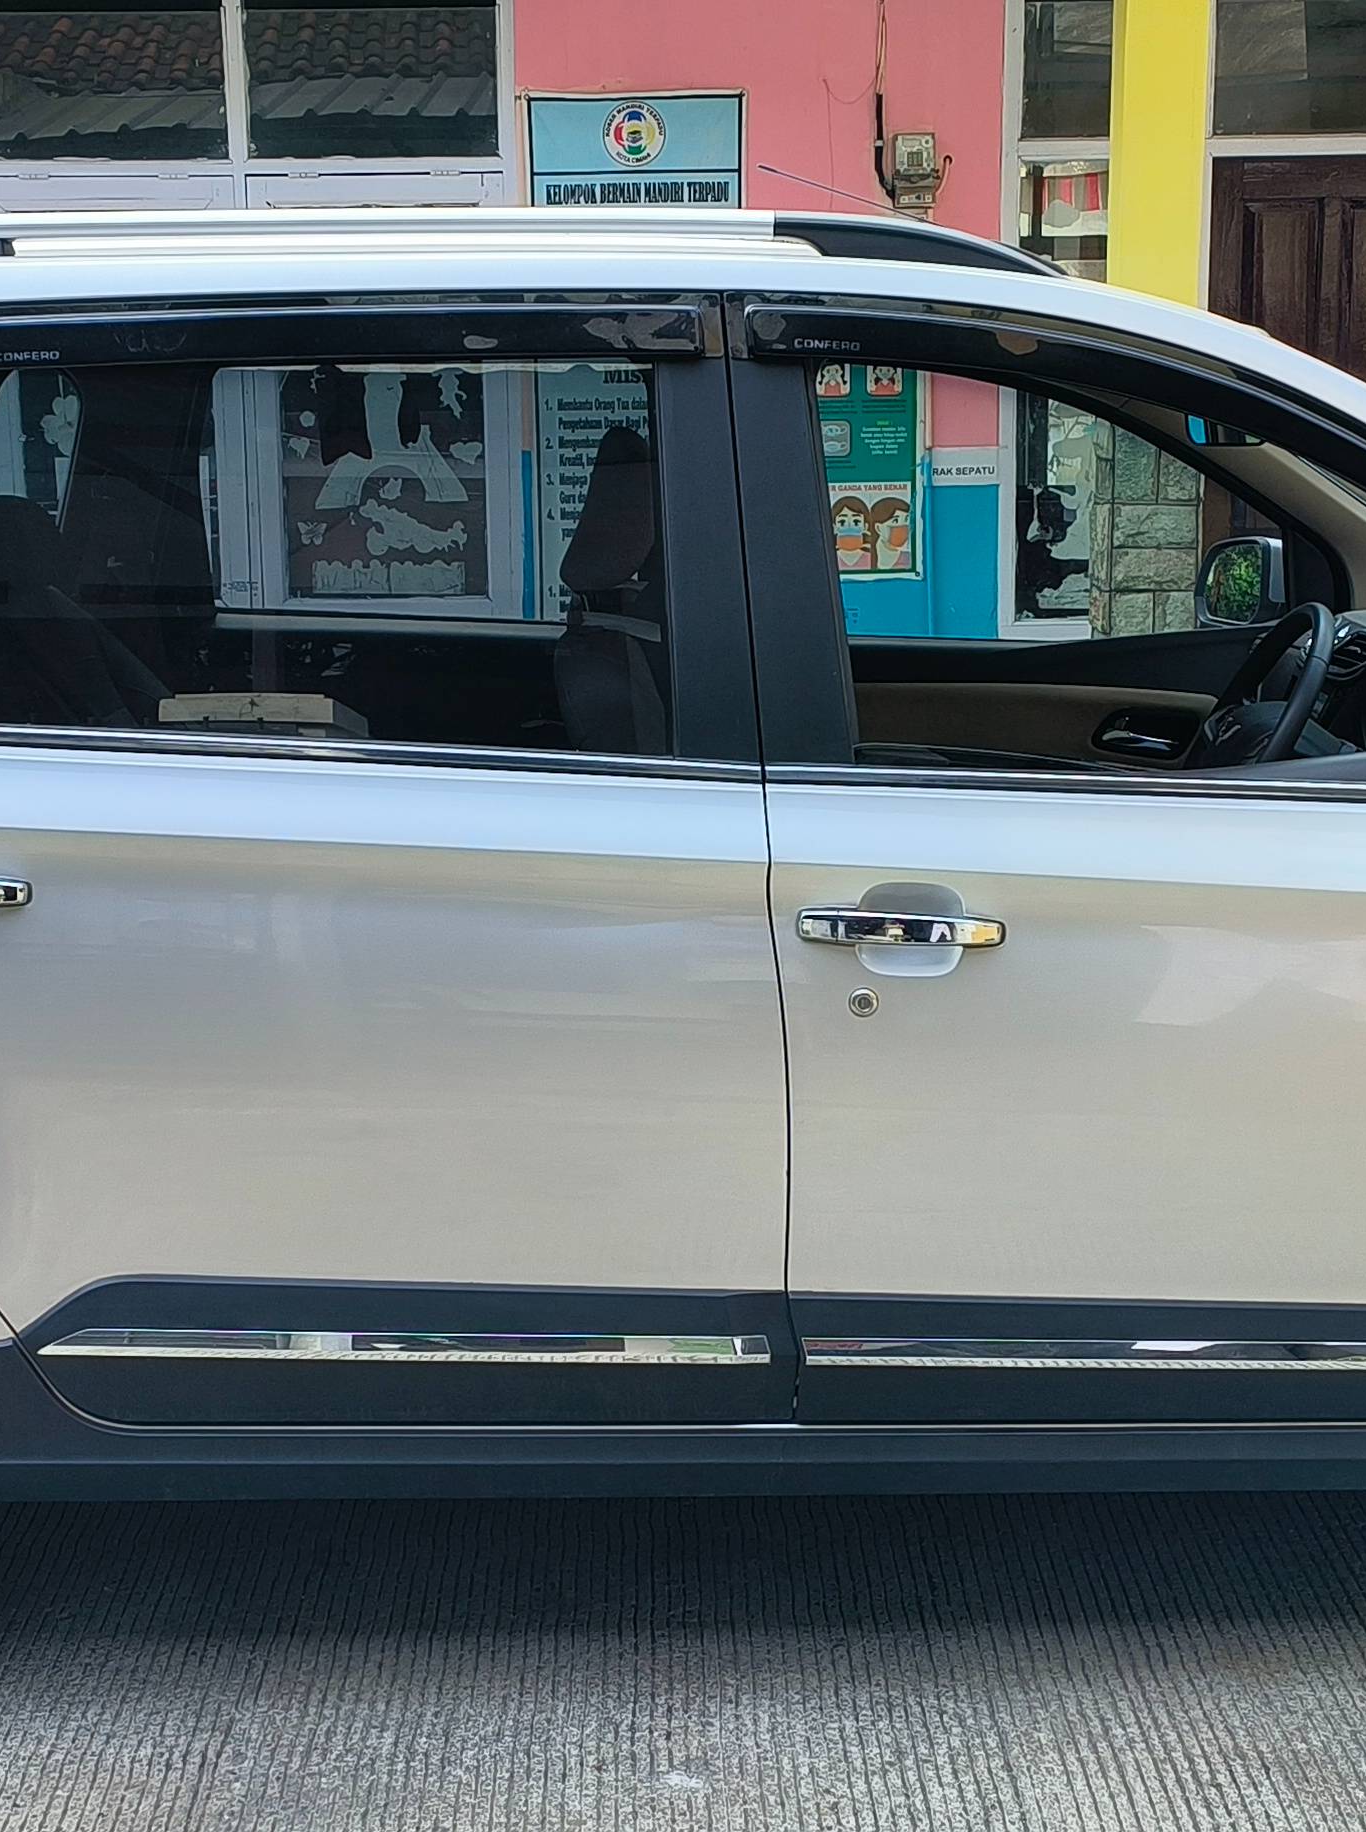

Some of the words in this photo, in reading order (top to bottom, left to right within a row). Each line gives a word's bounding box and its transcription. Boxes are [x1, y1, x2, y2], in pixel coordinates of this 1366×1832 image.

[546, 183, 597, 206] KELOMPOK
[599, 182, 642, 205] BERMAIN
[643, 181, 685, 203] MANDIRI
[686, 181, 730, 203] TERPADU
[794, 337, 861, 351] CONFERO
[545, 398, 553, 411] 1.
[594, 398, 616, 414] Orang
[545, 437, 554, 450] 2.
[933, 467, 953, 477] RAK
[955, 465, 995, 476] SEPATU
[546, 473, 555, 486] 3.
[863, 484, 882, 492] YANG
[546, 508, 555, 521] 4.
